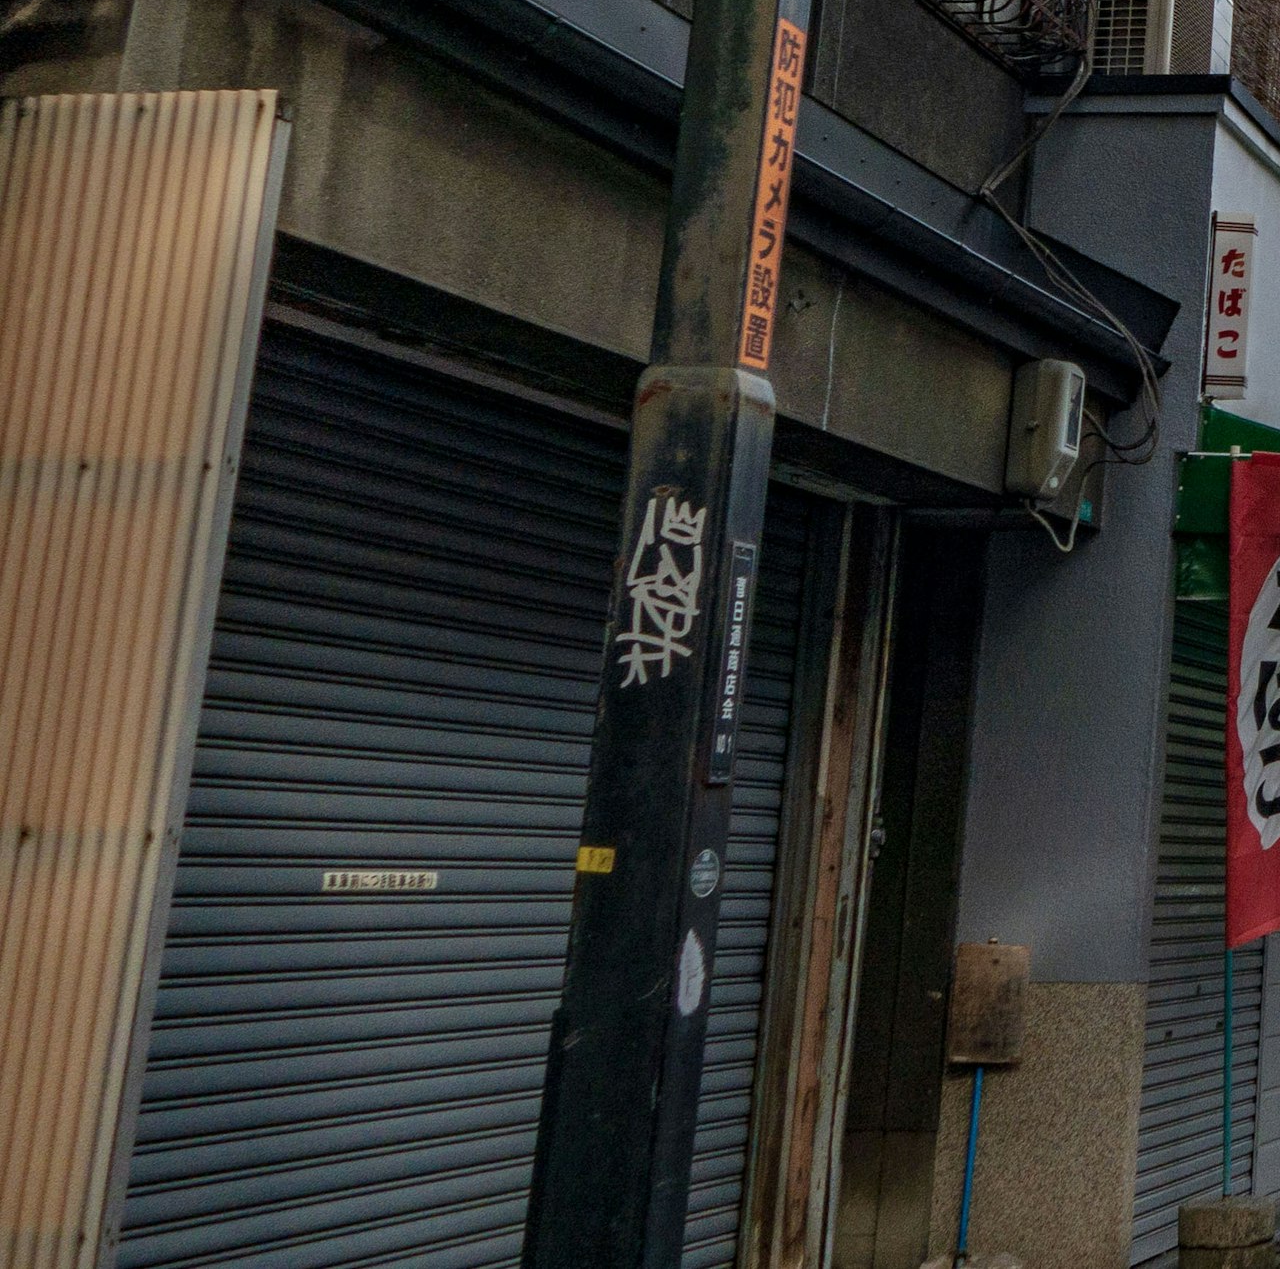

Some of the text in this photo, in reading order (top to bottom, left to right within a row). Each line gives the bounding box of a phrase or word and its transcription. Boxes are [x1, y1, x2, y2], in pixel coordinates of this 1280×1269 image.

[744, 27, 802, 363] 防犯カメラ設置
[1215, 248, 1246, 359] たばこ
